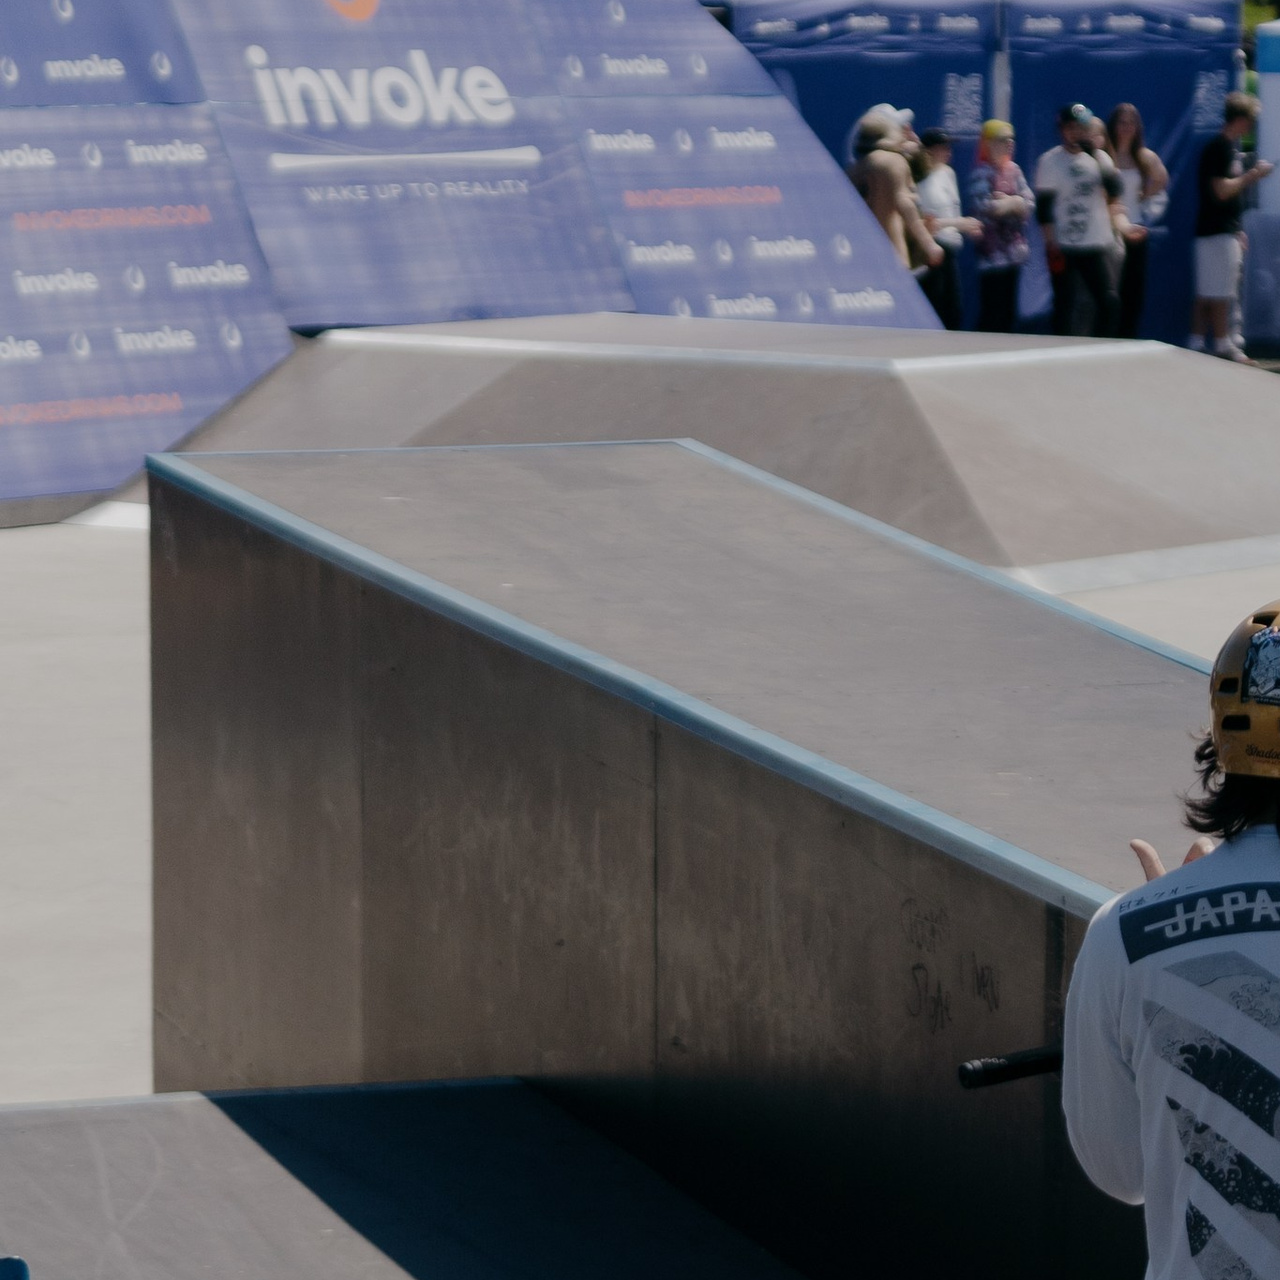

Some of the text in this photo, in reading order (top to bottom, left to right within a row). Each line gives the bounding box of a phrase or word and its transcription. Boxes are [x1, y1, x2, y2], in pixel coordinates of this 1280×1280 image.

[45, 53, 126, 80] invoke
[602, 52, 669, 77] invoke
[245, 43, 517, 128] invoke
[0, 138, 207, 167] voke invoke
[588, 126, 777, 153] invoke invoke
[304, 179, 529, 202] WAKE UP TO REALITY
[629, 234, 816, 264] invoke invoke
[15, 260, 251, 295] invoke invoke
[708, 286, 895, 317] invoke invoke
[0, 325, 197, 360] oke invoke
